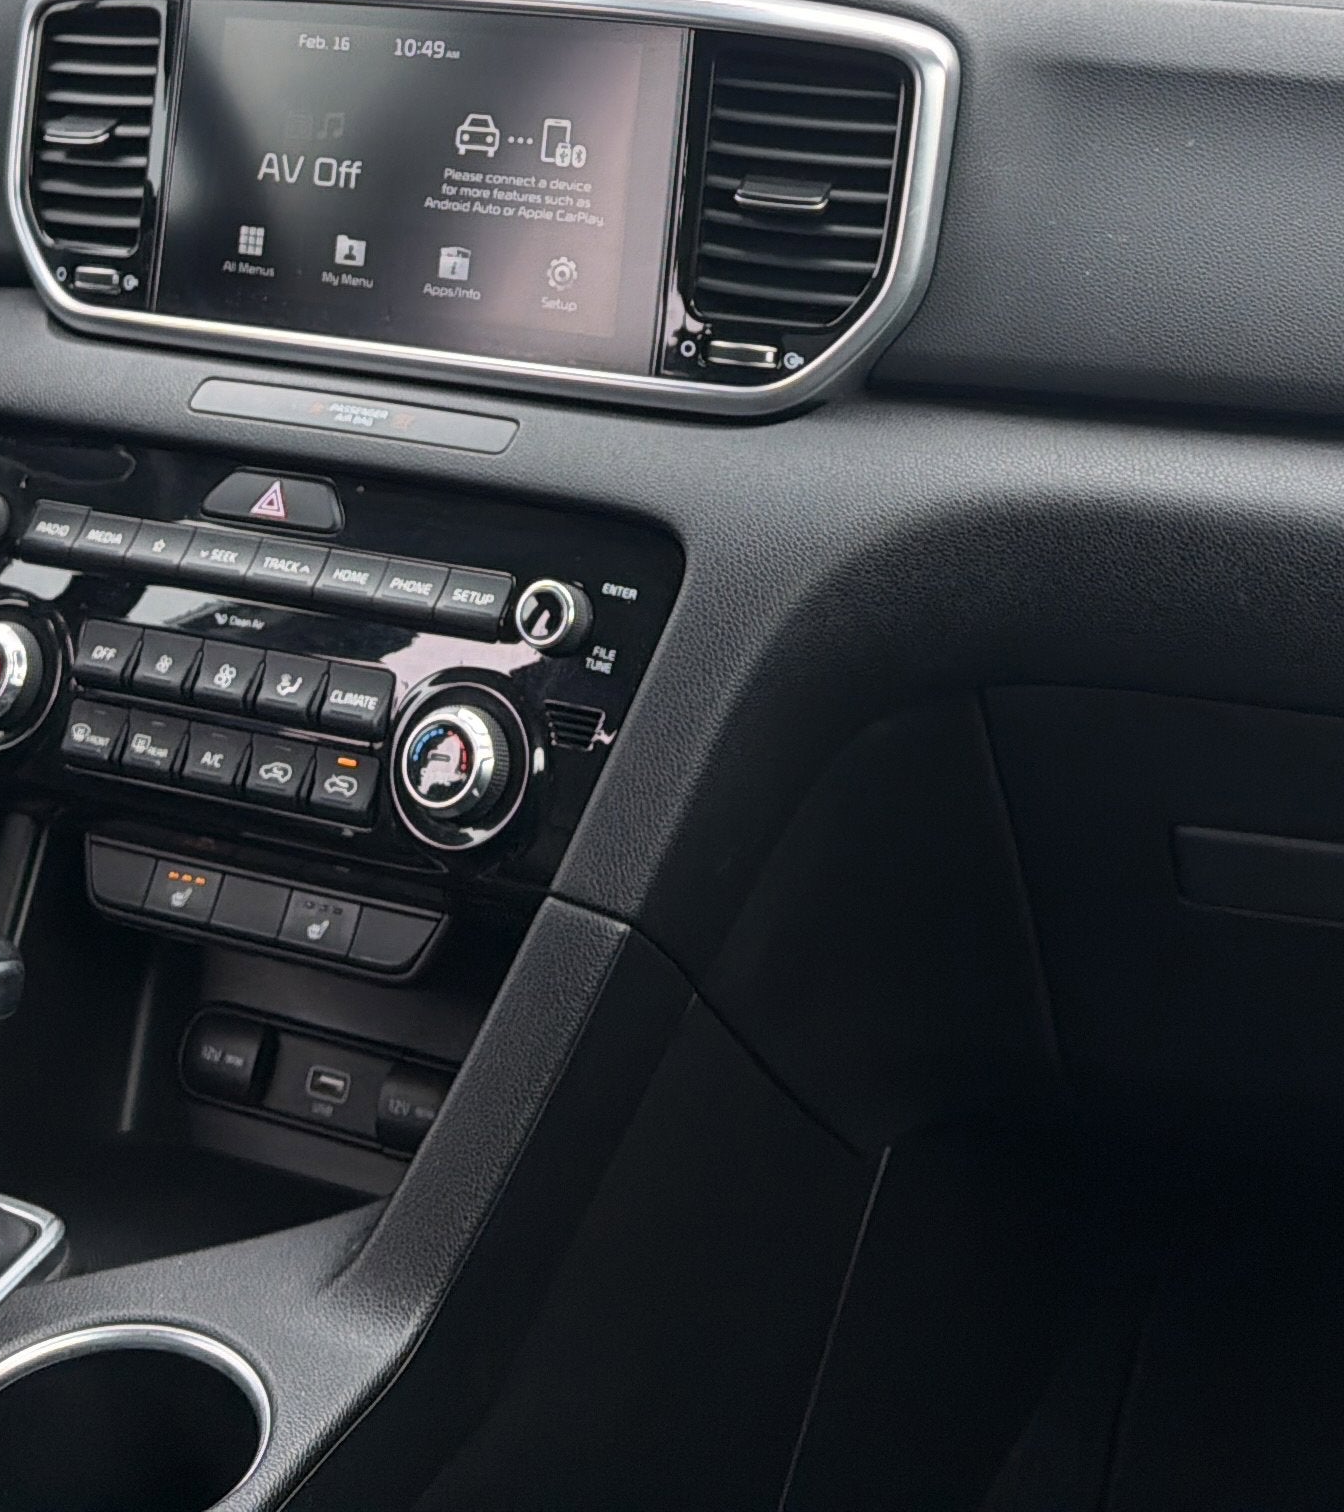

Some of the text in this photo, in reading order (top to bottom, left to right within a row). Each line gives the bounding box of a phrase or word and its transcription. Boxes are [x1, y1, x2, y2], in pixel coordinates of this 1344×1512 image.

[298, 33, 351, 51] Feb. 16
[394, 38, 446, 59] 10:49
[257, 152, 363, 189] AV Off
[443, 167, 483, 183] Please
[485, 173, 536, 188] connect
[549, 179, 592, 193] device
[441, 183, 591, 209] for more features such as
[424, 196, 471, 212] Android
[472, 201, 501, 216] Auto
[503, 206, 516, 217] or
[517, 205, 554, 221] Apple
[238, 261, 275, 278] Menus
[321, 271, 374, 289] My Menu
[423, 282, 481, 301] Apps/Info
[541, 296, 578, 312] Setup
[35, 521, 70, 537] RADIO
[86, 528, 123, 545] MEDIA
[208, 548, 239, 564] SEEK
[262, 556, 300, 574] TRACK
[332, 568, 370, 585] HOME
[389, 577, 433, 596] PHONE
[601, 582, 638, 601] ENTER
[452, 588, 495, 607] SETUP
[92, 645, 117, 661] OFF
[592, 645, 617, 662] FILE
[585, 657, 613, 675] TUNE
[330, 690, 379, 711] CLIMATE
[201, 751, 224, 768] A/C
